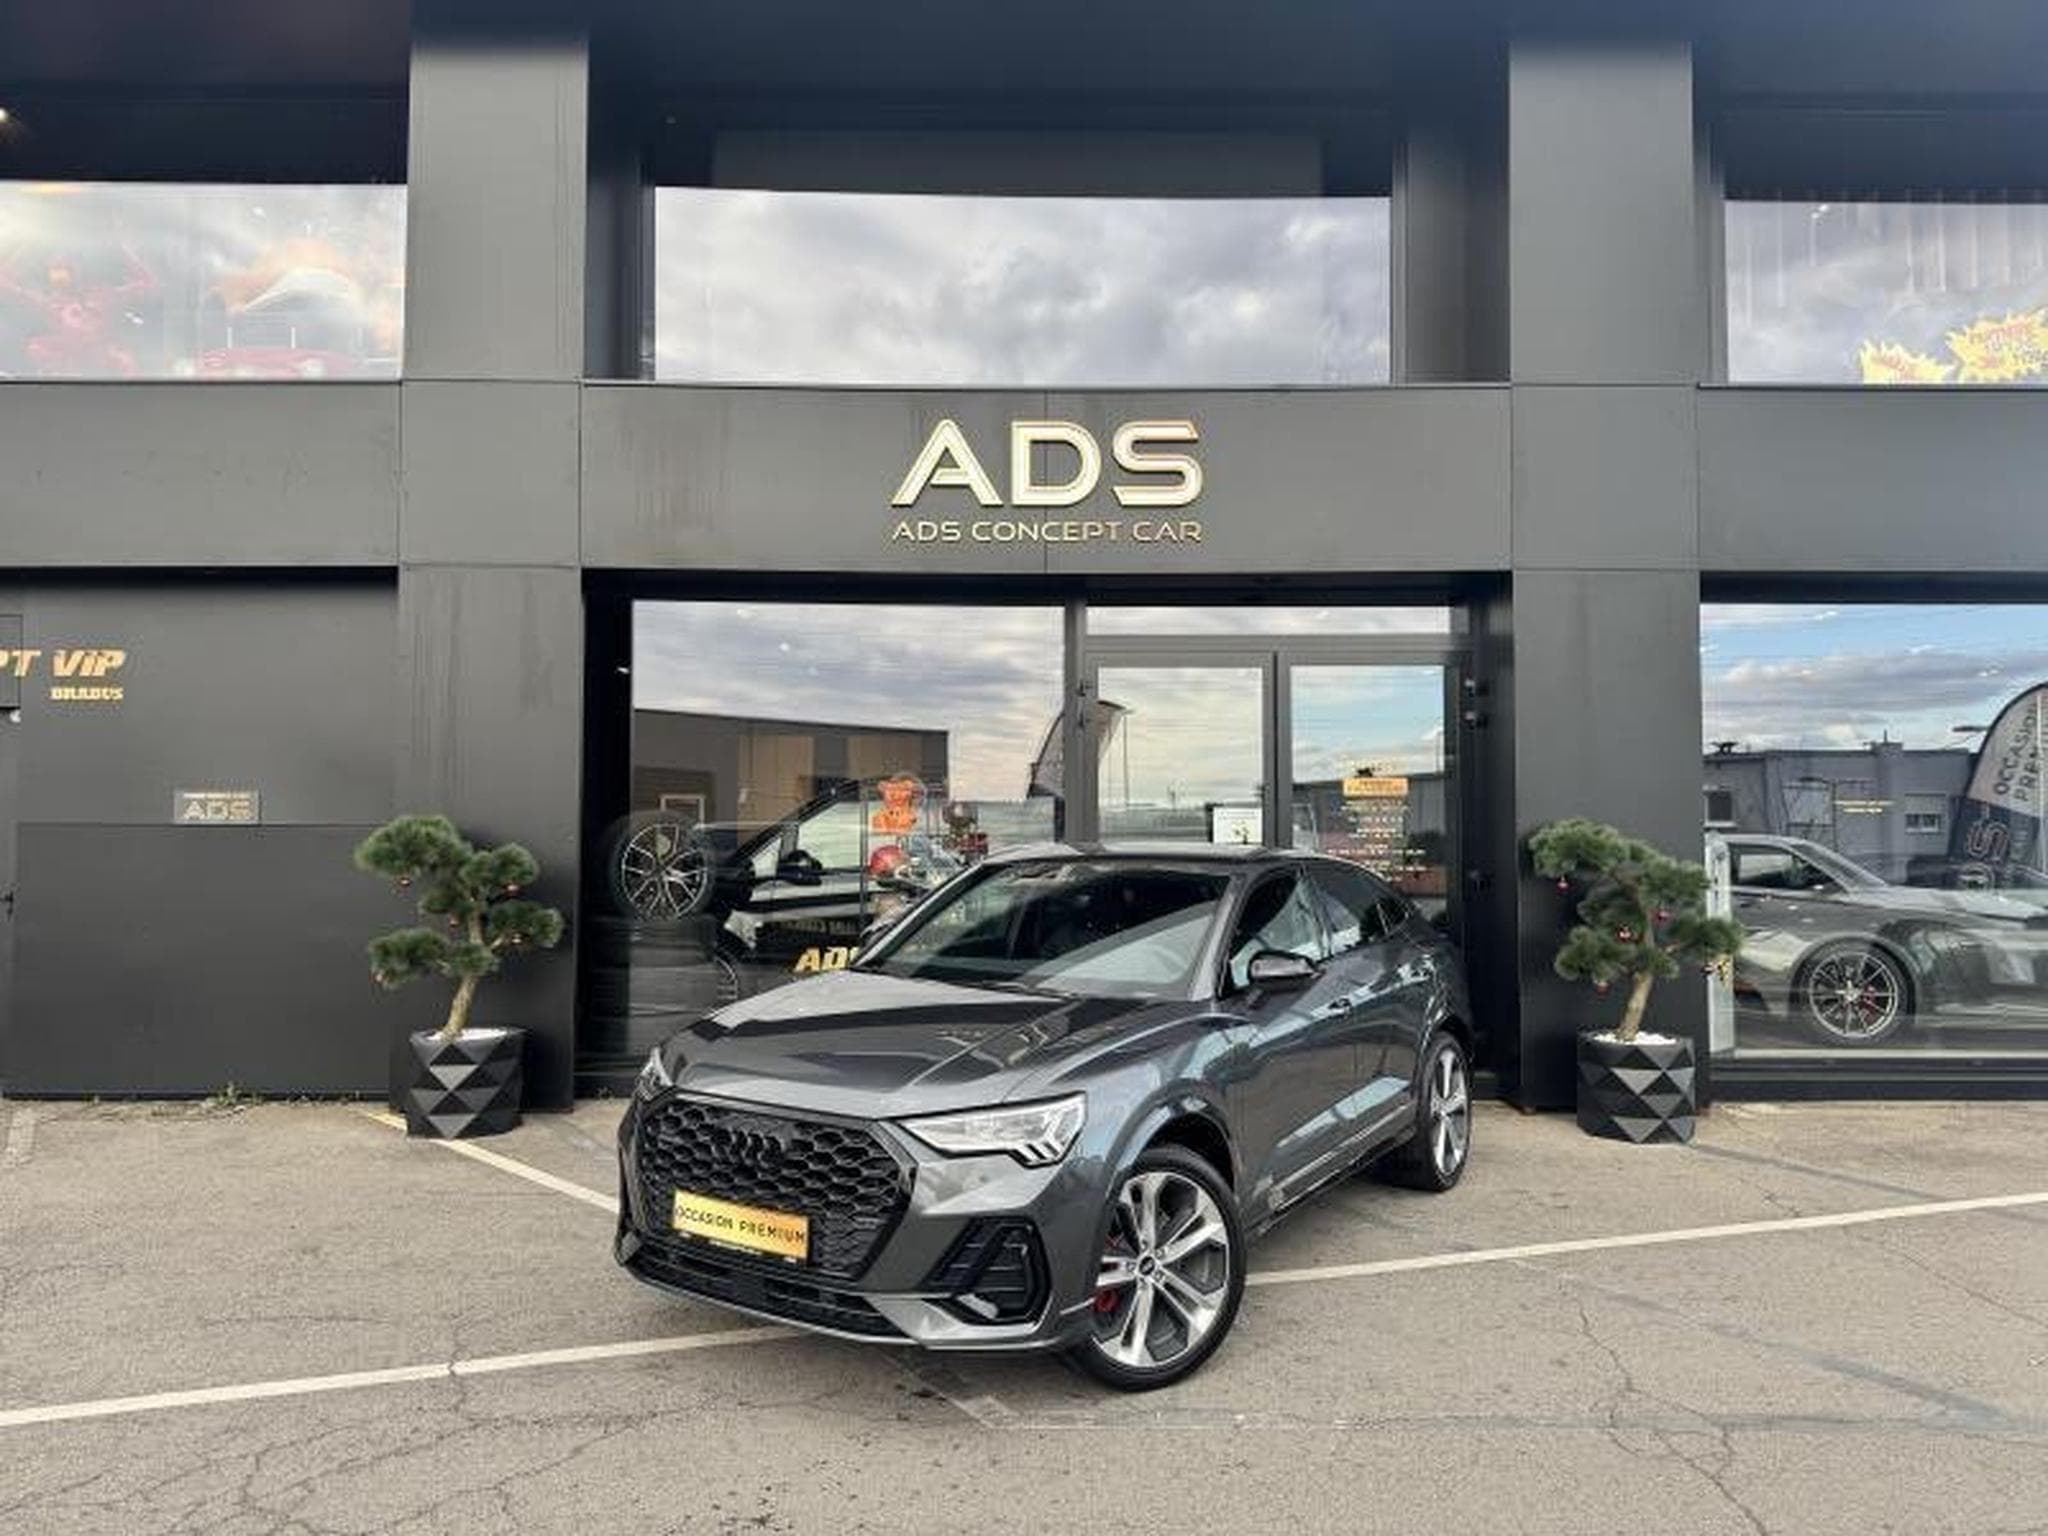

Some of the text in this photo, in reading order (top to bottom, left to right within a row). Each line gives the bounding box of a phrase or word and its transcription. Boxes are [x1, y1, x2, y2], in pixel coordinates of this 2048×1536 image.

[892, 418, 1202, 507] ADS
[892, 520, 1203, 542] ADS CONCEPT CAR
[673, 1203, 806, 1243] OCCASION PREMIUM
